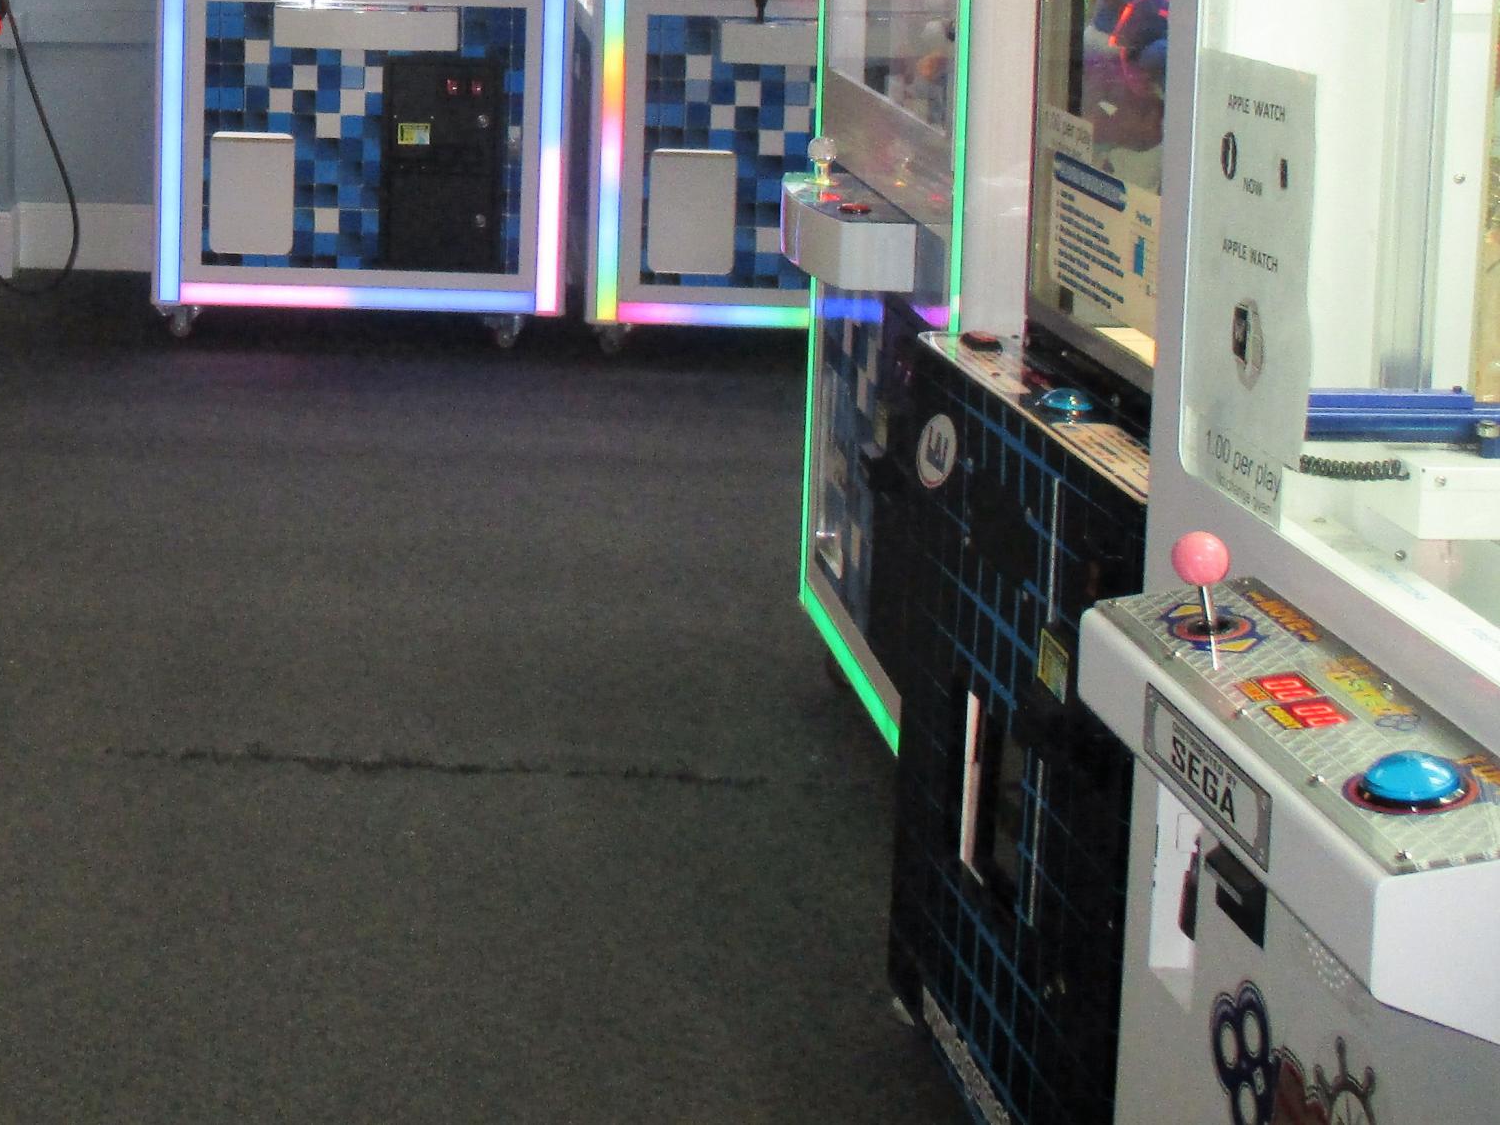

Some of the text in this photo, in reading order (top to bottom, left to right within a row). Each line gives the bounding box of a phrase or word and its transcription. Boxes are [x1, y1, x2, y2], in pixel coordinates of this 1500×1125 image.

[1228, 93, 1286, 122] APPLE WATCH
[1222, 238, 1279, 273] APPLE WATCH
[1232, 451, 1253, 478] per
[1255, 462, 1282, 503] play
[1171, 736, 1236, 824] SEGA
